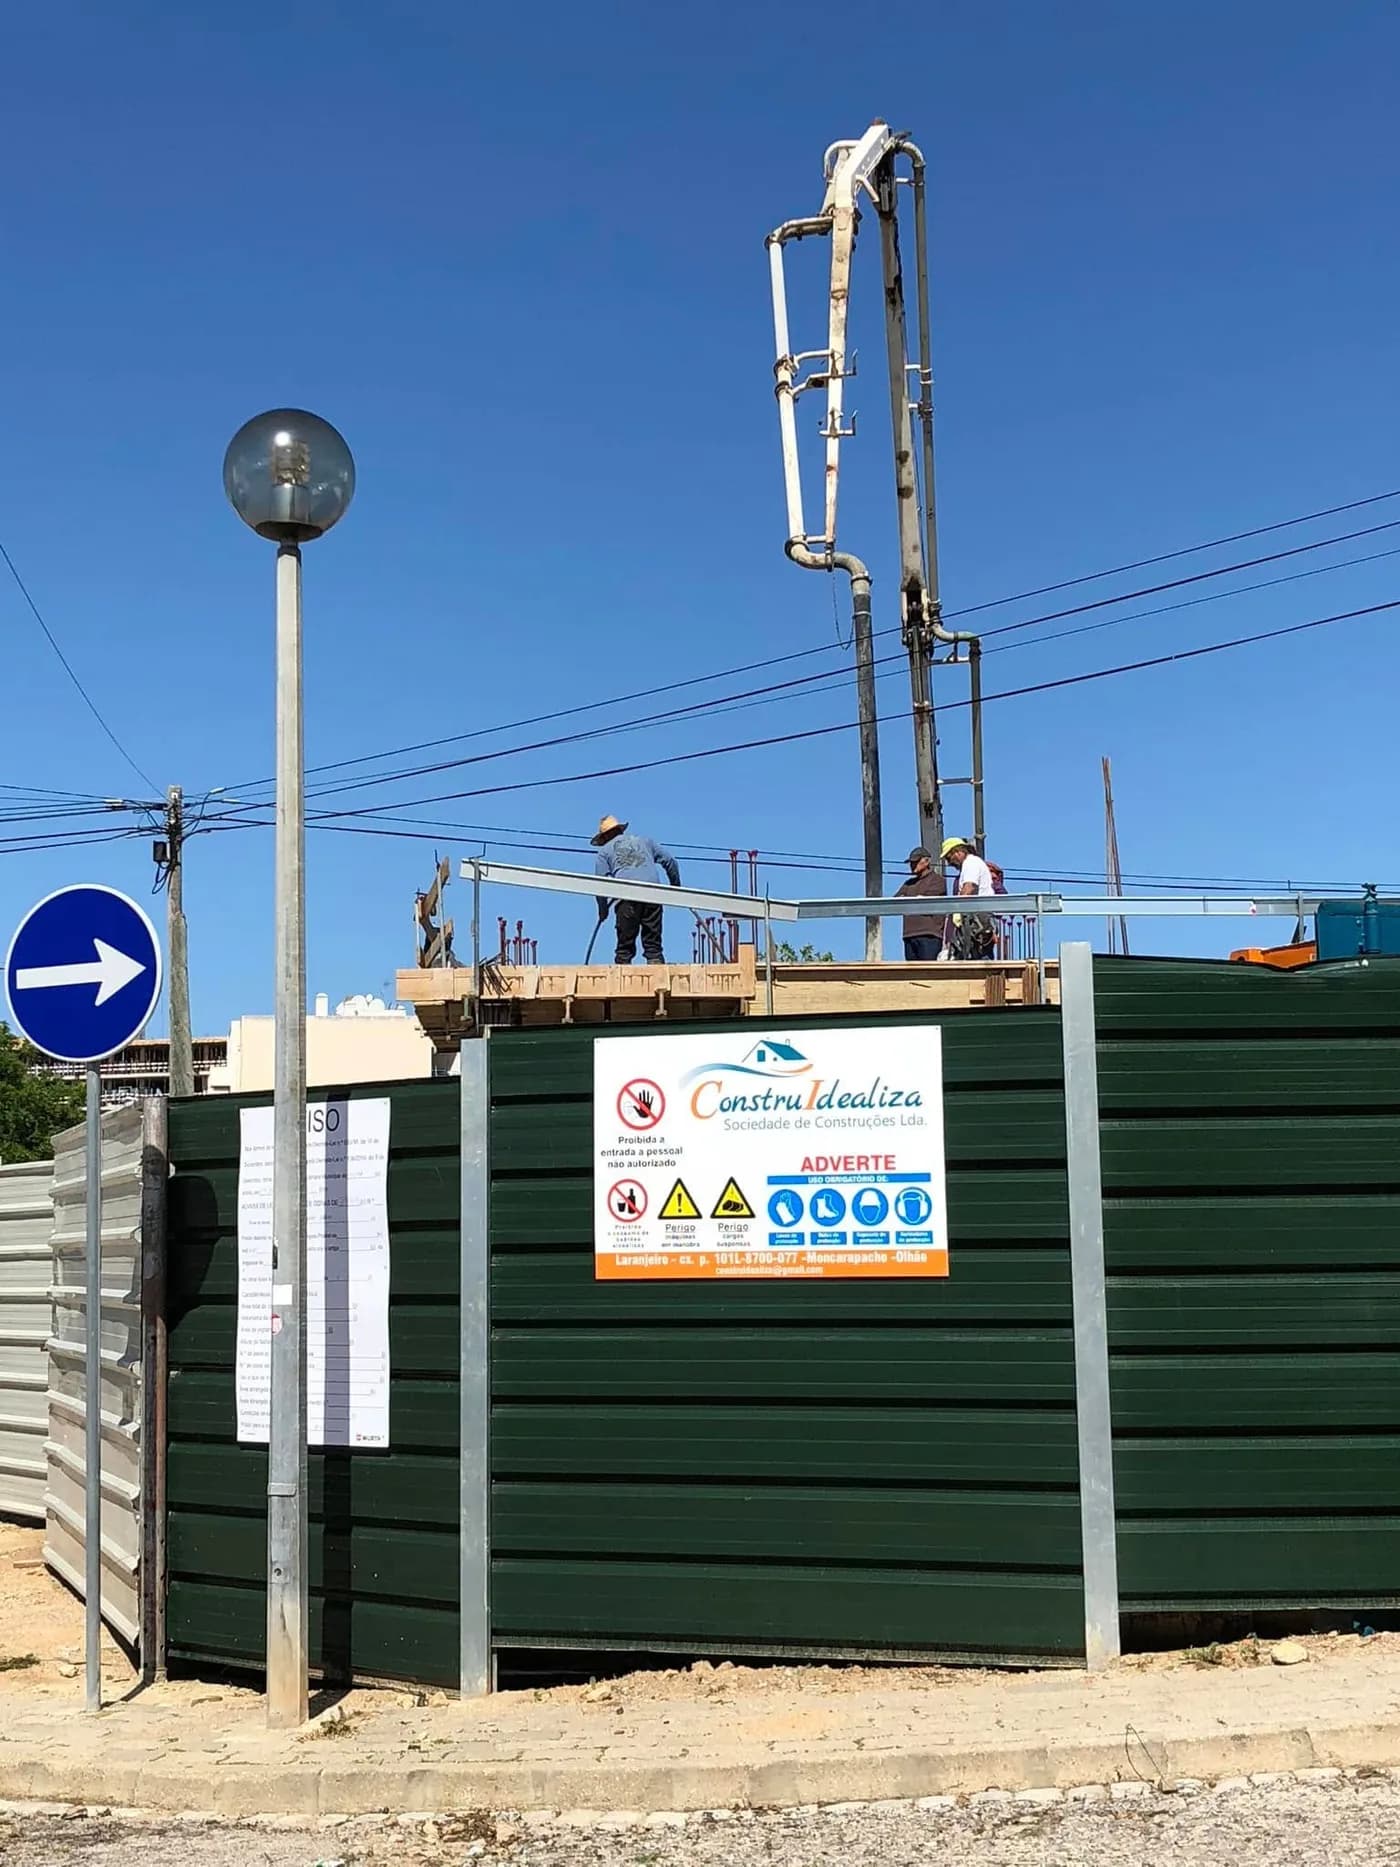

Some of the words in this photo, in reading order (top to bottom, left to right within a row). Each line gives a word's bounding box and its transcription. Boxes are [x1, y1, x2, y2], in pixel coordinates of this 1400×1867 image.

[307, 1108, 340, 1132] ISO
[723, 1117, 790, 1131] Sociedade
[794, 1116, 811, 1128] de
[814, 1115, 896, 1130] Construções
[900, 1114, 928, 1126] Lda.
[618, 1136, 657, 1144] Proibida
[600, 1148, 636, 1156] entrada
[646, 1147, 683, 1157] pessoal
[627, 1160, 677, 1168] autorizado
[800, 1155, 897, 1172] ADVERTE
[665, 1223, 696, 1233] Perigo
[718, 1222, 749, 1232] Perigo
[615, 1253, 669, 1266] Laranjeiro
[699, 1255, 709, 1267] p.
